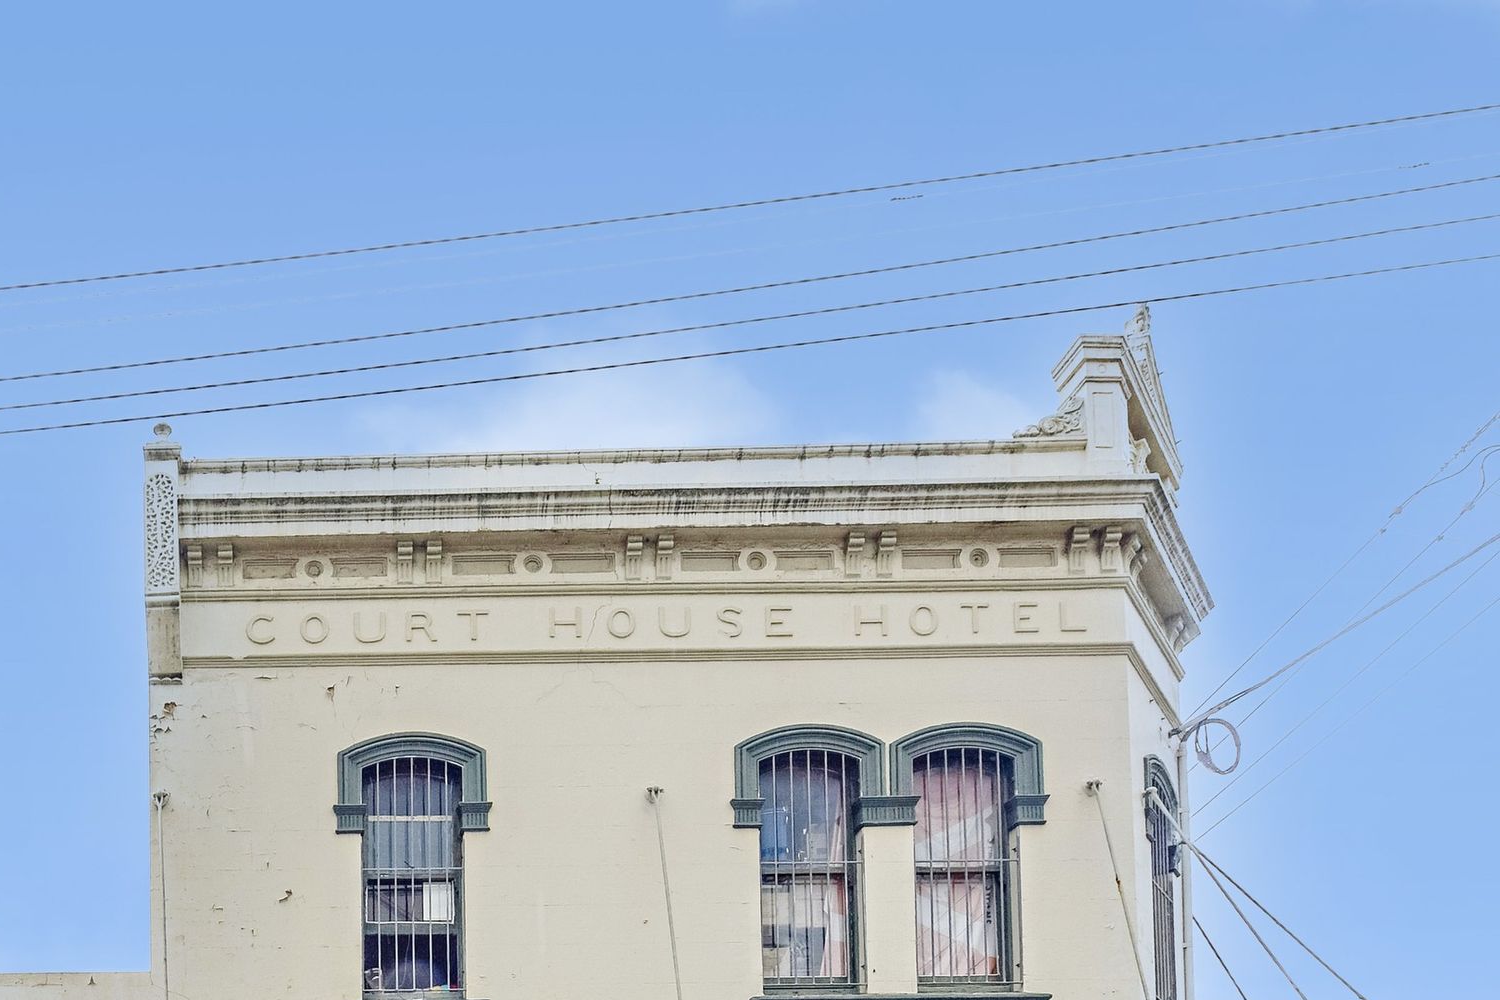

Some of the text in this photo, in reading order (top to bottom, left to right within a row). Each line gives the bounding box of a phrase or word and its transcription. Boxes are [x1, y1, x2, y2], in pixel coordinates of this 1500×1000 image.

[246, 601, 1089, 645] COURT HOUSE HOTEL
